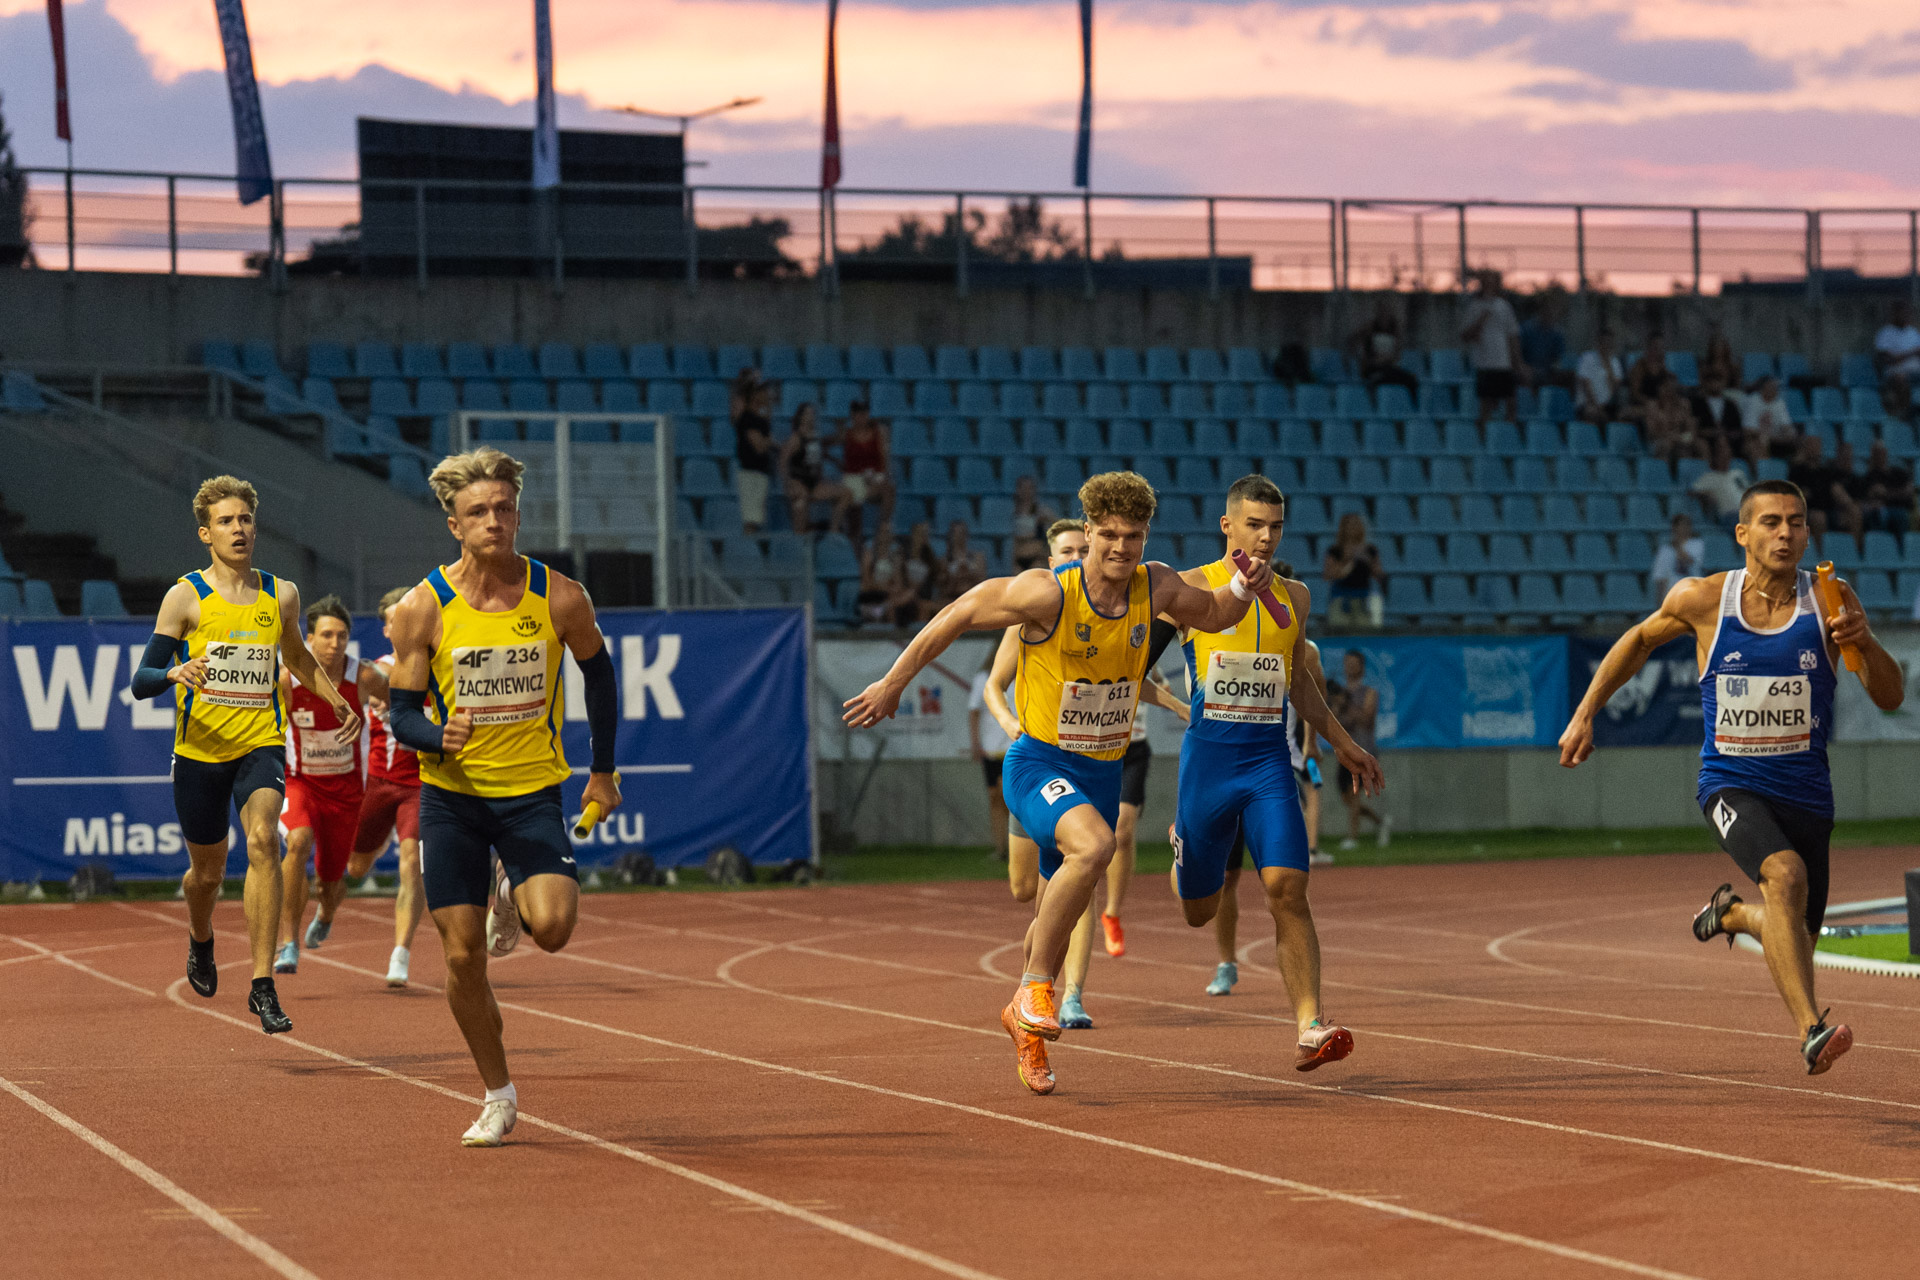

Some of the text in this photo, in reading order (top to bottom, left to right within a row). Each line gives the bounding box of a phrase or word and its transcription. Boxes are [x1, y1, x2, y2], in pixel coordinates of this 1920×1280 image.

[258, 615, 272, 623] VIS
[517, 621, 537, 630] VIS
[210, 645, 271, 661] 4F 233
[458, 647, 540, 668] 4F 236
[1253, 657, 1279, 671] 602
[207, 667, 270, 685] BORYNA
[458, 673, 544, 697] ŻACZKIEWICZ
[1108, 685, 1131, 700] 611
[1214, 678, 1276, 698] GÓRSKI
[1768, 681, 1803, 696] 643
[473, 713, 520, 723] ŁOCŁAWEK
[1061, 709, 1131, 727] SZYMCZAK
[1720, 709, 1805, 727] AYDINER
[1048, 780, 1067, 797] 5
[1720, 802, 1733, 828] 4
[64, 812, 238, 856] Mias
